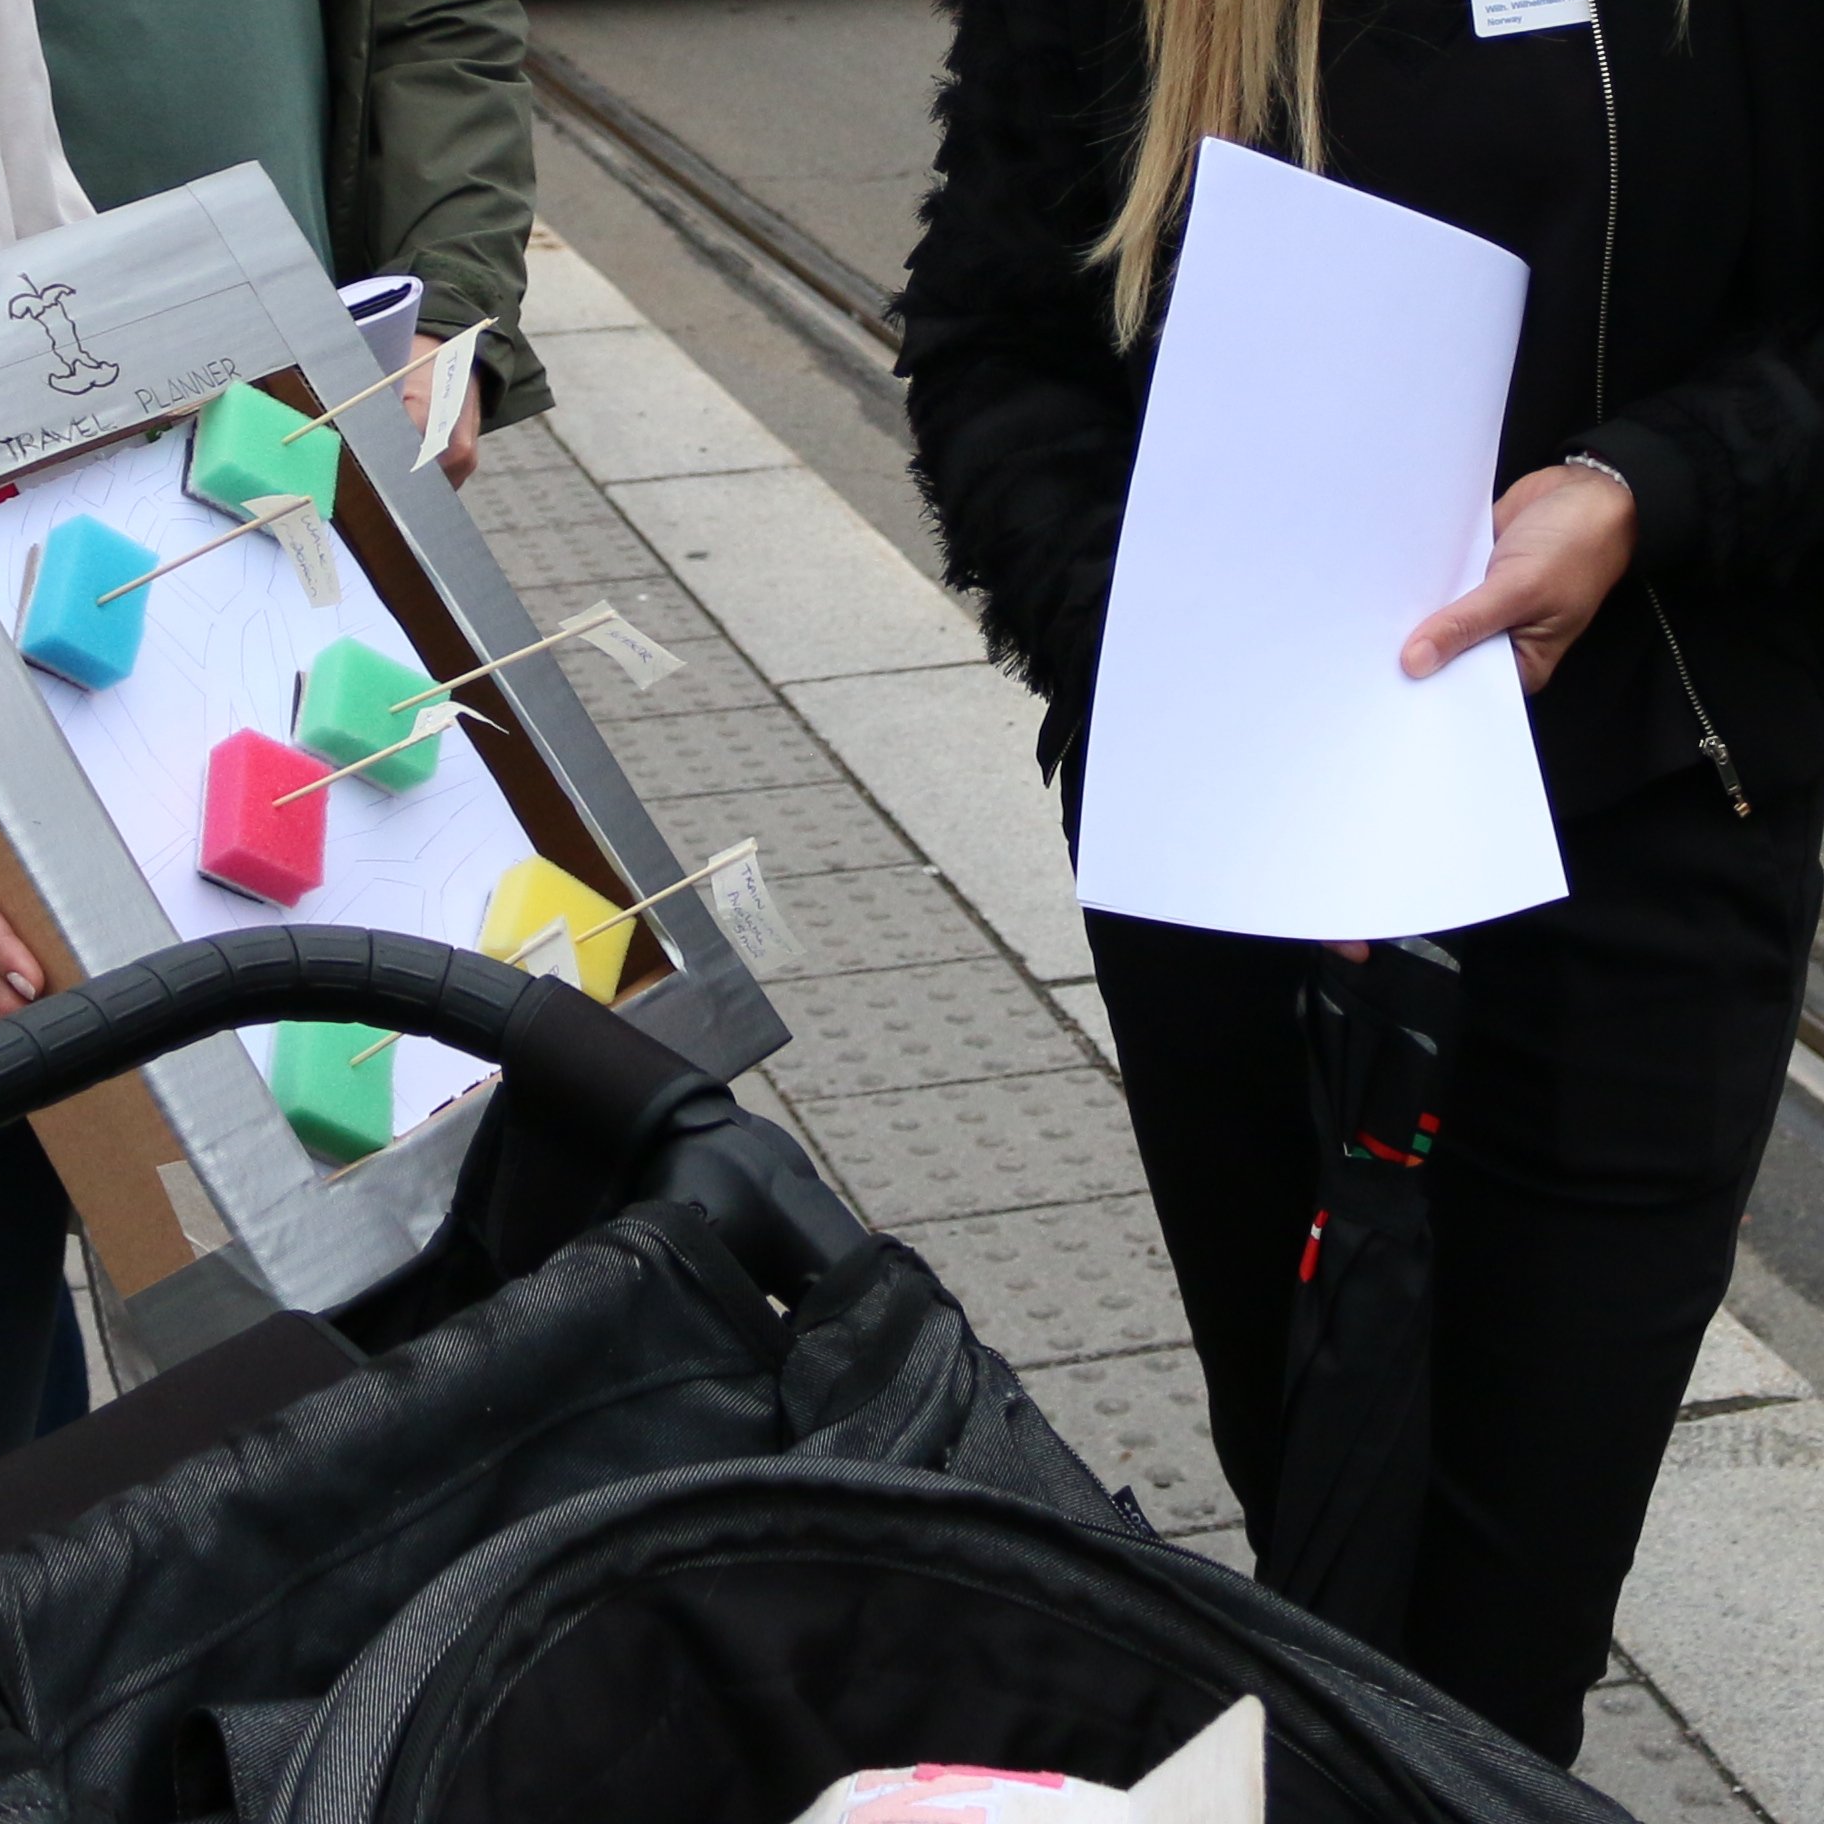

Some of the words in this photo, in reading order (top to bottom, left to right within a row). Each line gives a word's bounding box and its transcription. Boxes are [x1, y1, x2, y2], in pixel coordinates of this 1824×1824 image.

[0, 413, 118, 463] TRAVEL
[135, 357, 242, 415] PLANNER
[741, 861, 766, 911] TRAIN
